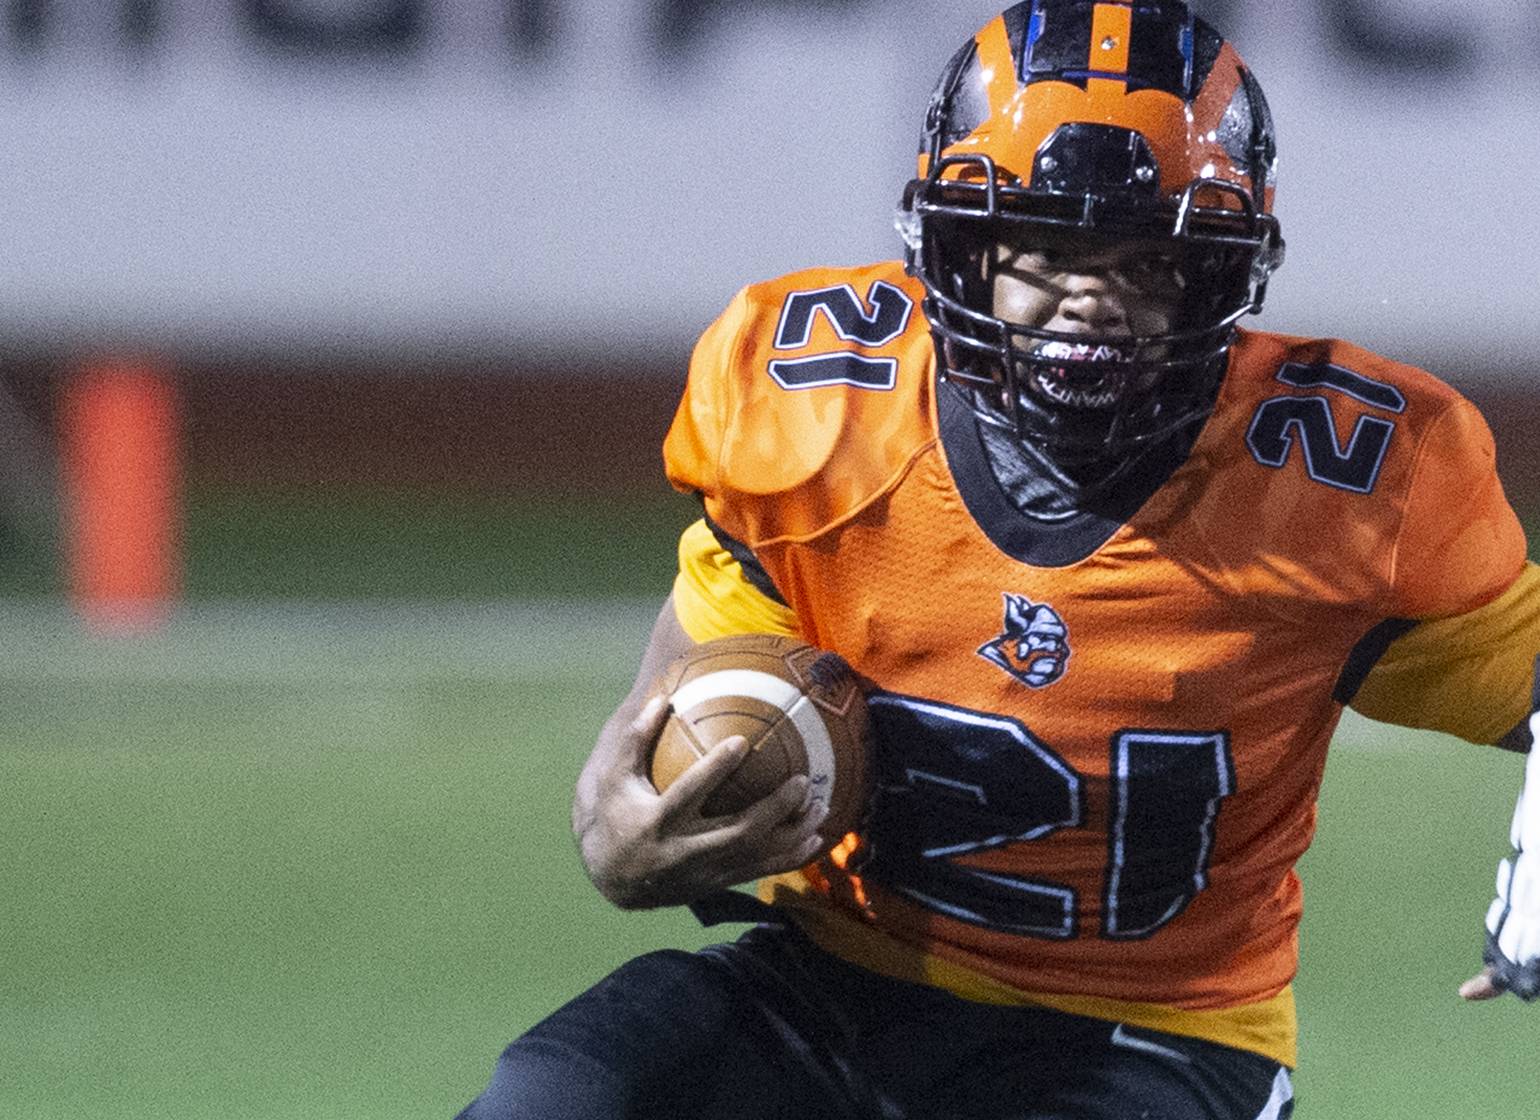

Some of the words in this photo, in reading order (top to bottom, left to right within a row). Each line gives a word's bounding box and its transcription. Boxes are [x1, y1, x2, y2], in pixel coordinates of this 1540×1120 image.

[768, 279, 914, 392] 21
[1245, 361, 1408, 495] 21
[867, 690, 1237, 942] 21
